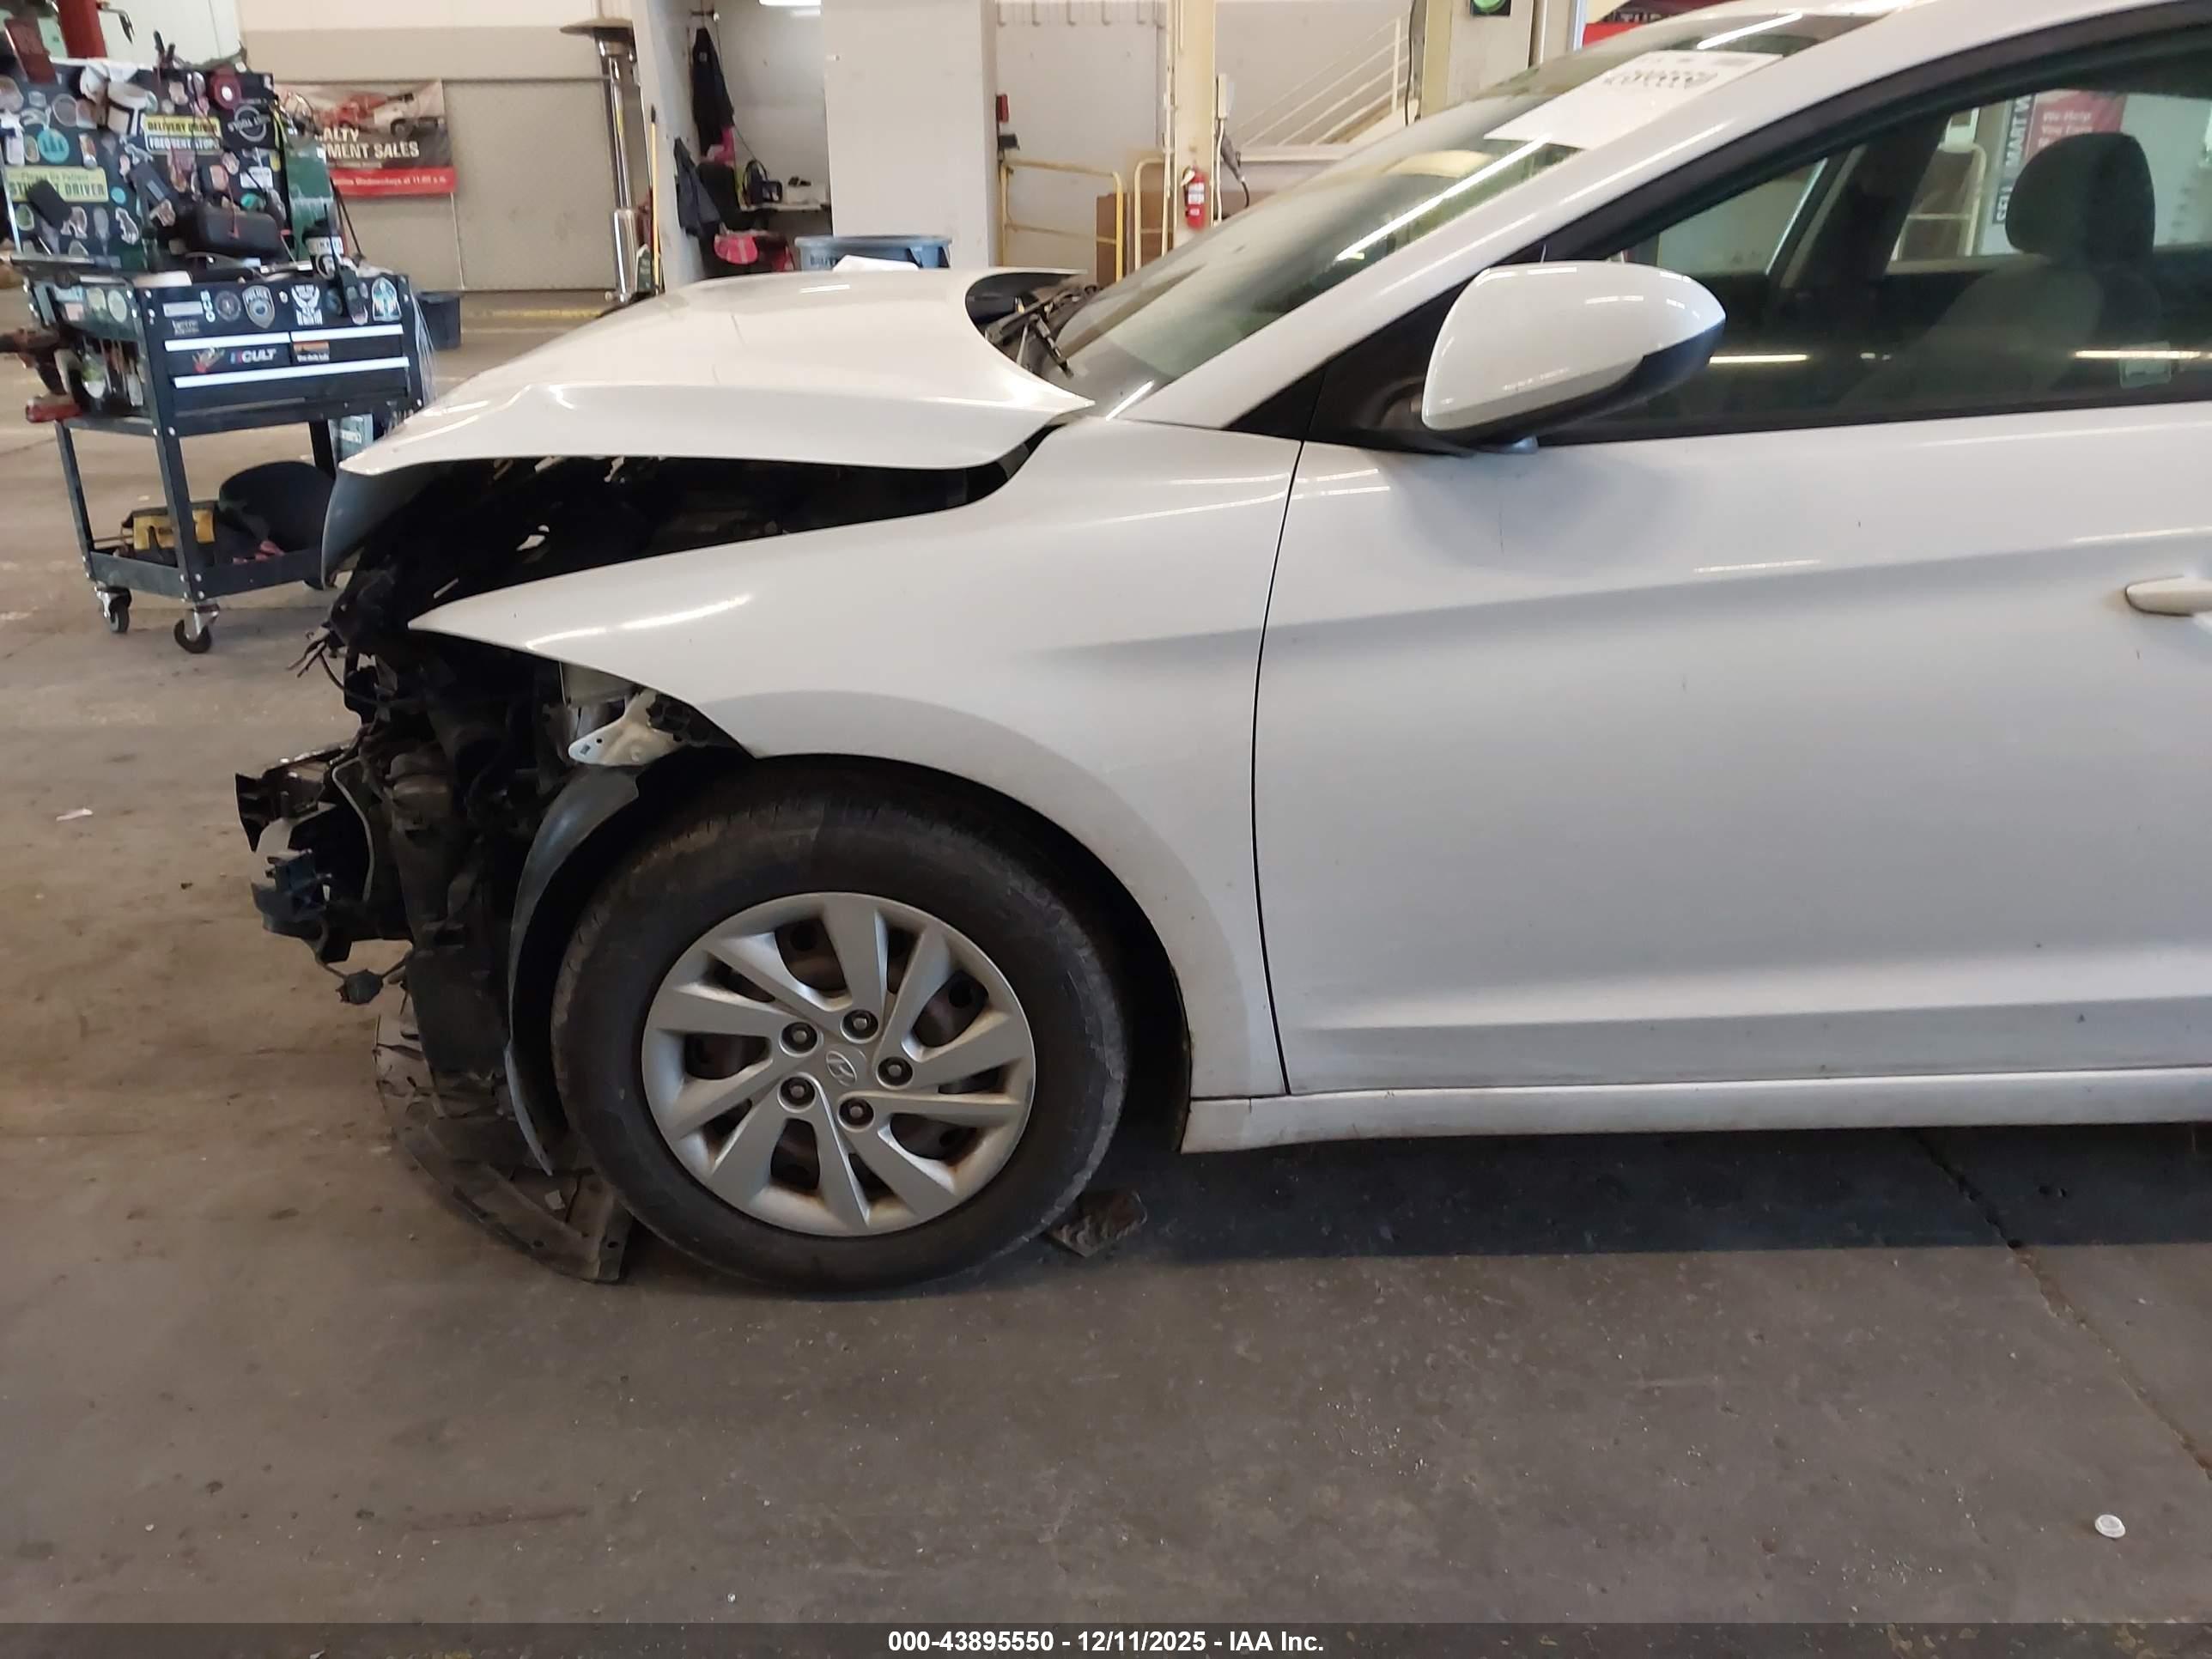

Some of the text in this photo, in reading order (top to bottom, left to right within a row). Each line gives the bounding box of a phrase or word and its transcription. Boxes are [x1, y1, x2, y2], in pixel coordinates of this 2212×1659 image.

[148, 120, 185, 132] DELIVERY
[149, 137, 192, 149] FREQUENT
[374, 141, 419, 159] SALES
[65, 182, 105, 197] DRIVER
